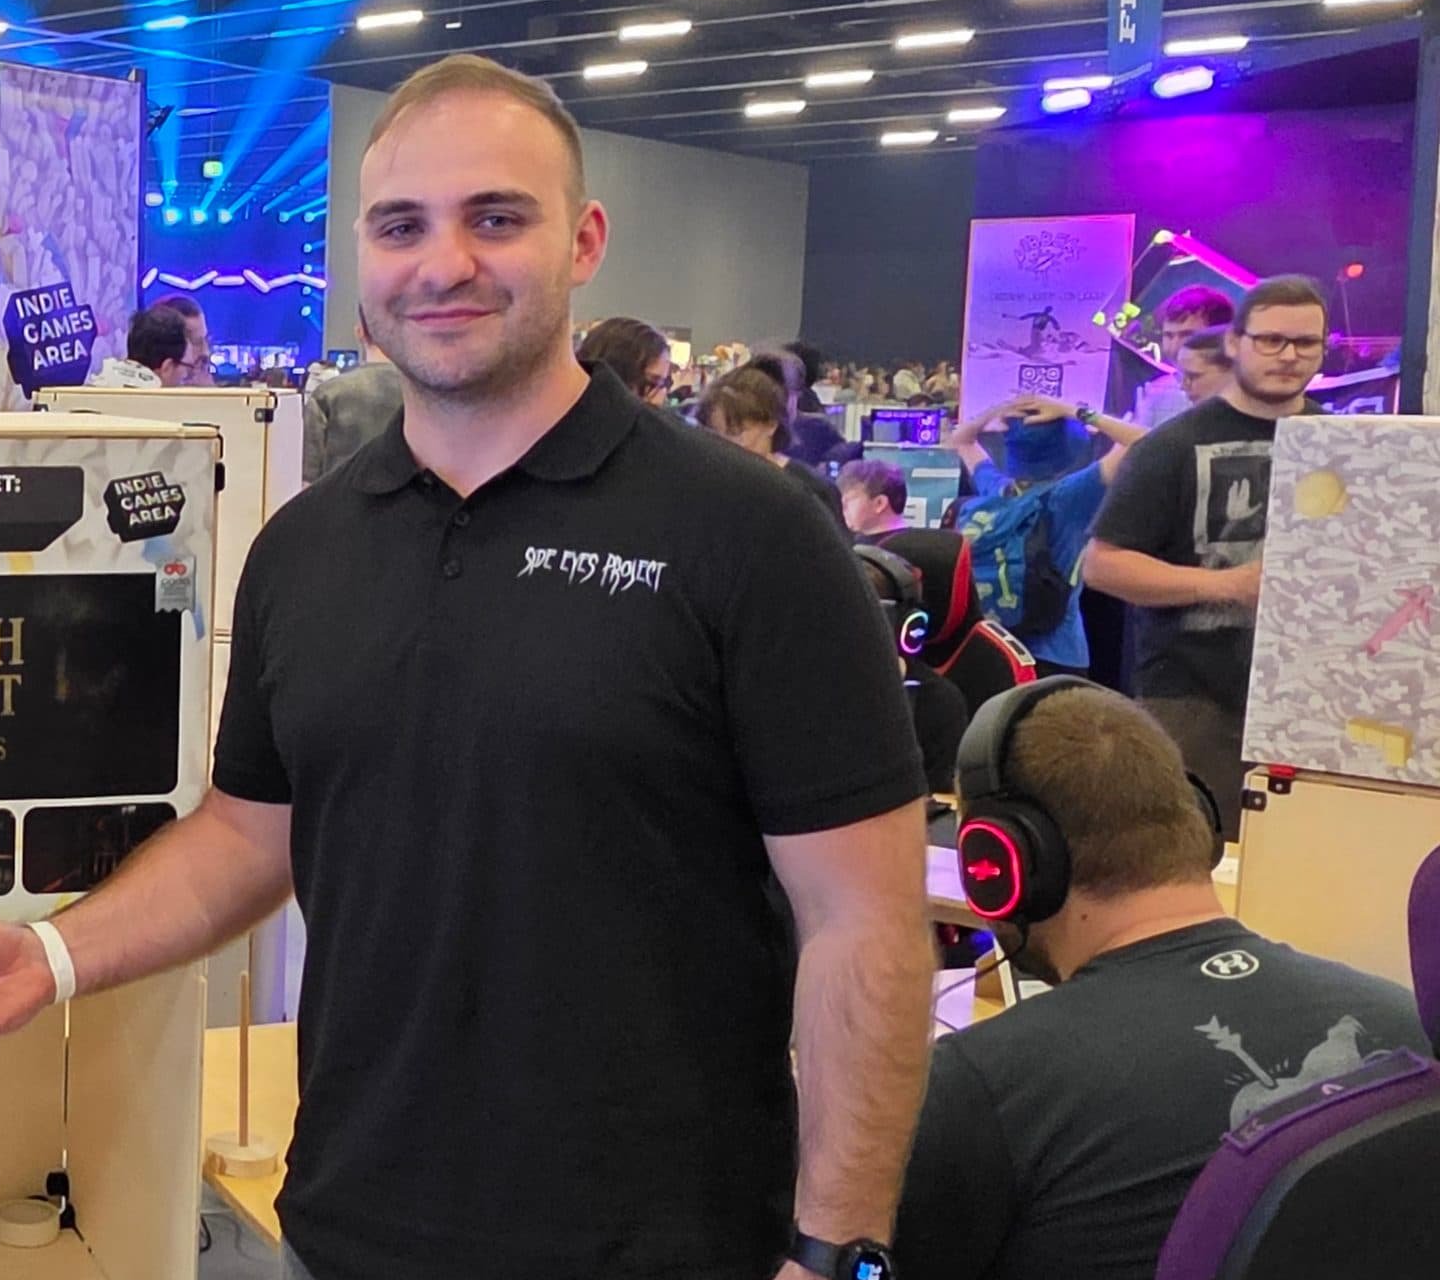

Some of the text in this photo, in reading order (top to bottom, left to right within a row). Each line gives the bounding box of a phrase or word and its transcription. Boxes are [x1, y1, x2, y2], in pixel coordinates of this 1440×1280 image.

[15, 288, 73, 319] INDIE
[23, 310, 93, 344] GAMES
[33, 339, 89, 371] AREA
[114, 475, 164, 496] INDIE
[120, 487, 182, 511] GAMES
[129, 505, 177, 527] AREA
[559, 549, 600, 585] EYES
[599, 552, 668, 596] PROJECT
